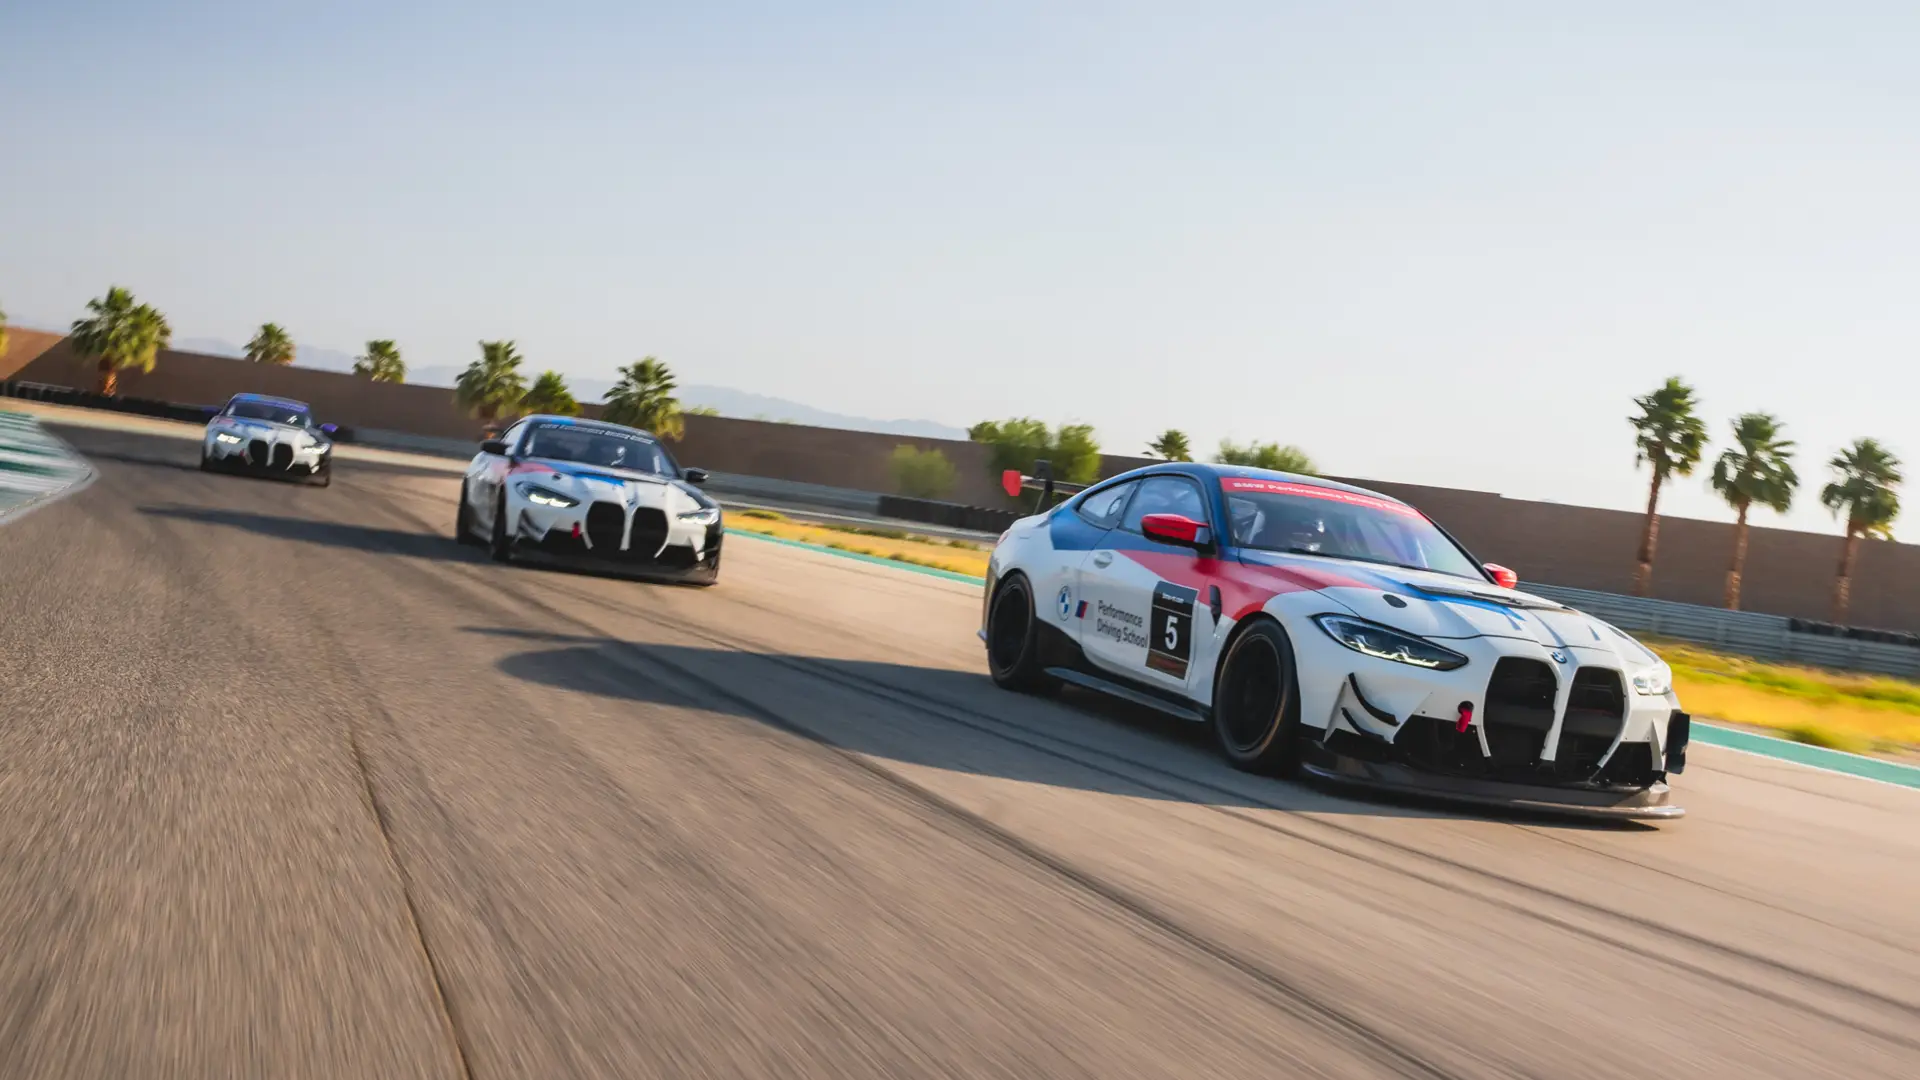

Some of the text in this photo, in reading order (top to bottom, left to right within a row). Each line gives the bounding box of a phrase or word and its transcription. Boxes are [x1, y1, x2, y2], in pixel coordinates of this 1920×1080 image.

[1098, 600, 1143, 628] Performance
[1097, 618, 1148, 648] Driving School
[1164, 615, 1178, 650] 5
